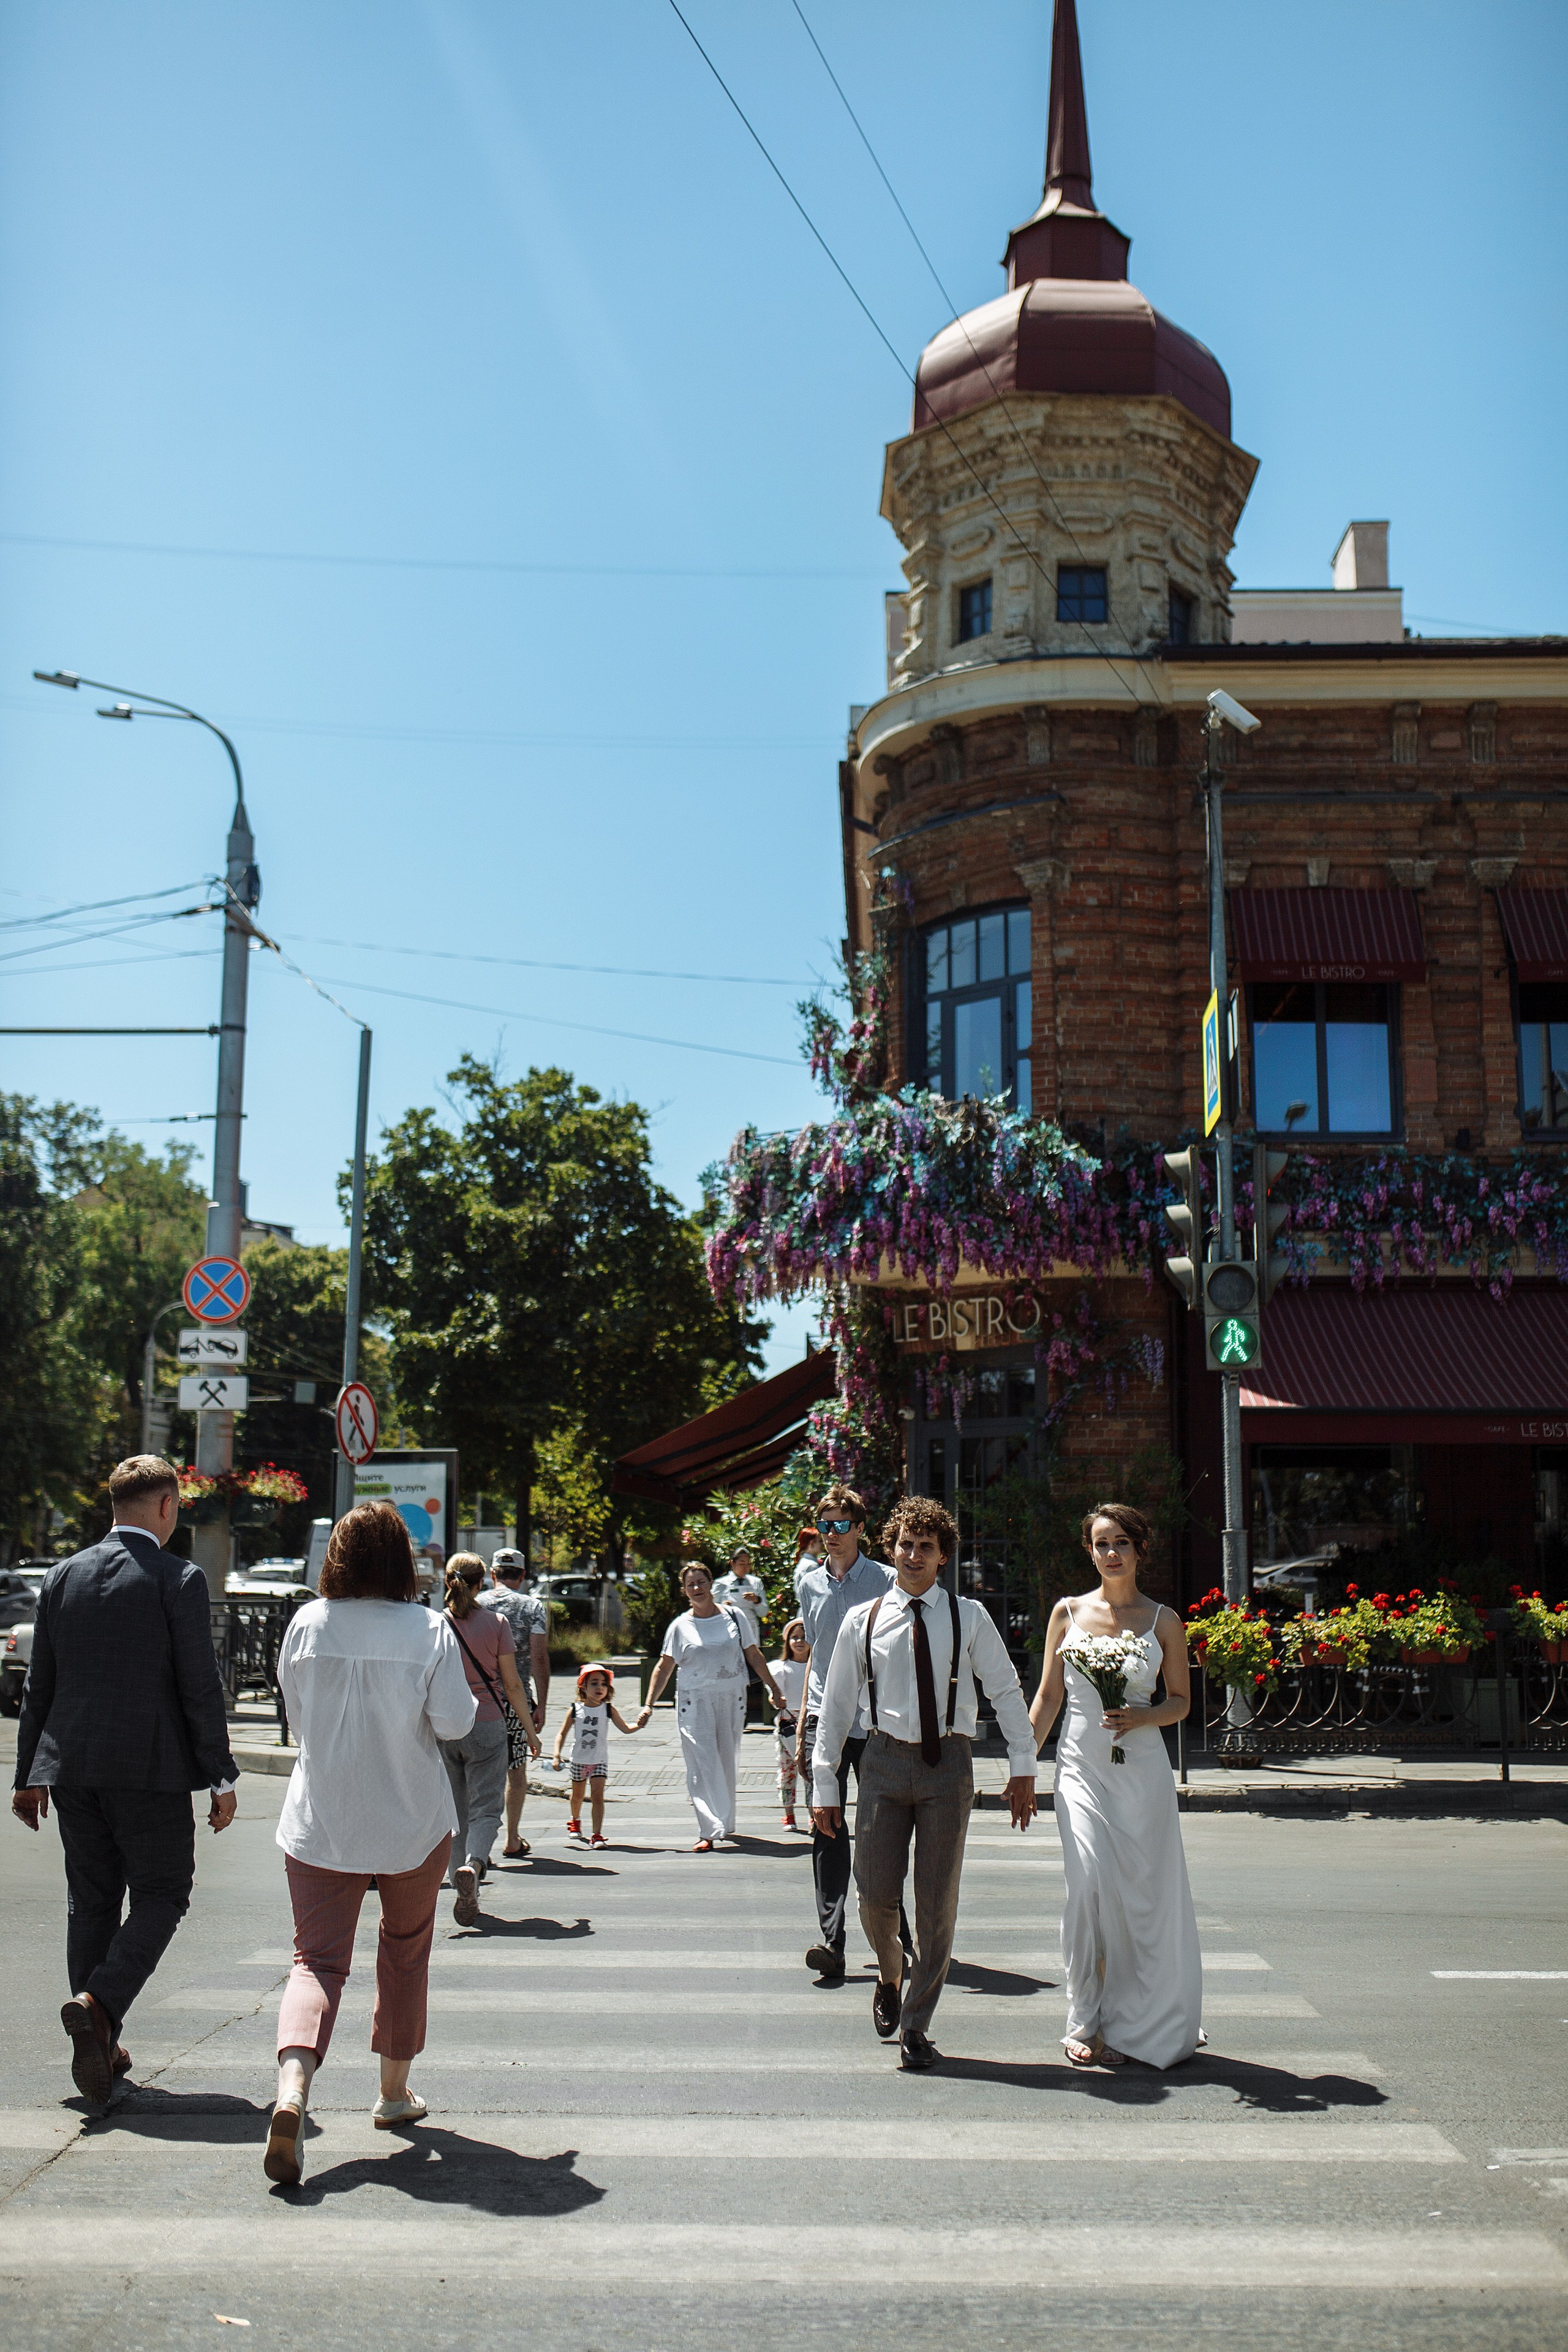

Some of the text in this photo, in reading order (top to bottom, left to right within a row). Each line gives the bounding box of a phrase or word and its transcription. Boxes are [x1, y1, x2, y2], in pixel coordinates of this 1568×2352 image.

[1302, 965, 1317, 979] LE
[1320, 965, 1365, 979] BISTRO
[893, 1295, 1040, 1343] LE BISTRO
[1520, 1422, 1538, 1438] LE
[355, 1485, 427, 1495] ужные услуги
